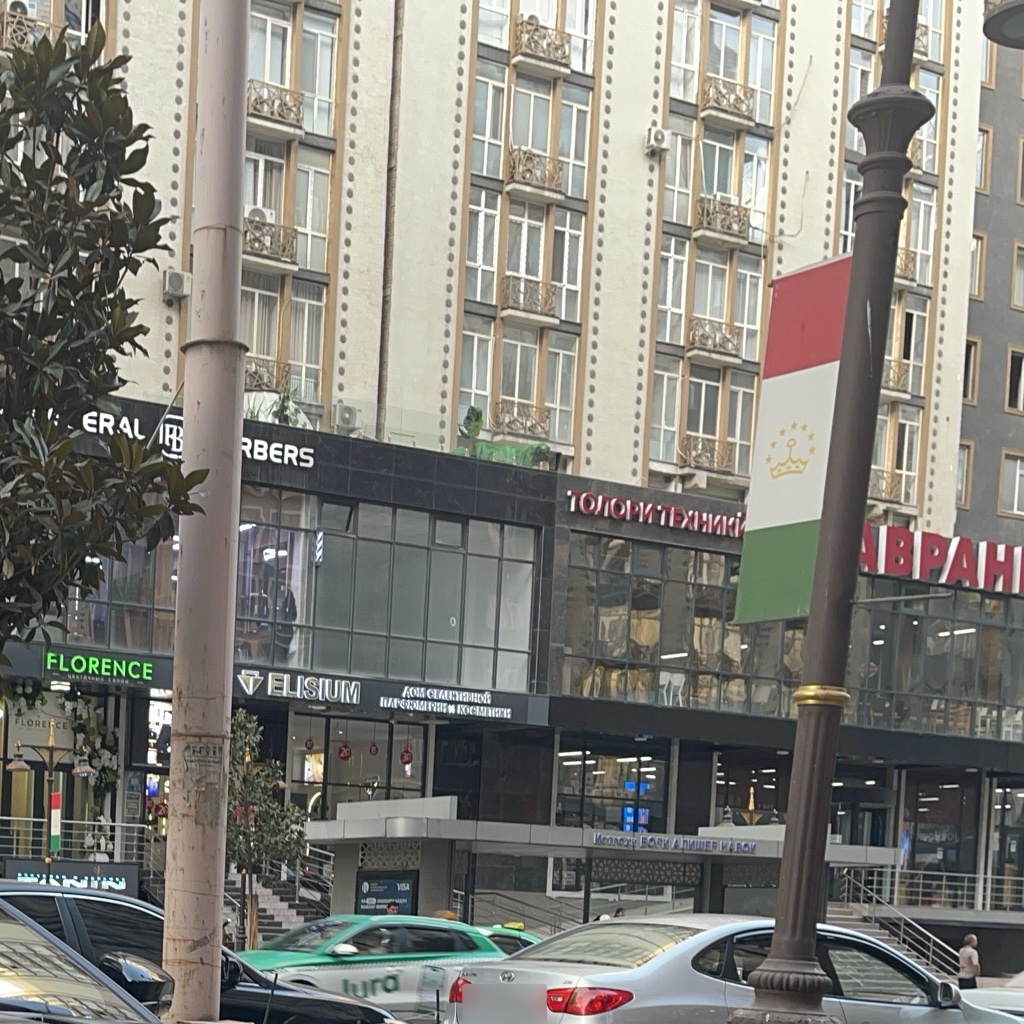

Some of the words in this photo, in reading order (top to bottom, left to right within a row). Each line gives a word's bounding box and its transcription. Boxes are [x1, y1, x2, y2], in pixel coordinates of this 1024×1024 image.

[240, 437, 315, 468] RBERS
[566, 489, 655, 524] ТОЛОРИ
[45, 652, 154, 681] FLORENCE
[266, 671, 362, 705] ELISIUM
[402, 685, 427, 699] ДОМ
[379, 696, 448, 714] ПАРФЮМЕРИИ
[456, 704, 512, 719] КОСМЕТИКИ
[396, 882, 410, 892] VISA
